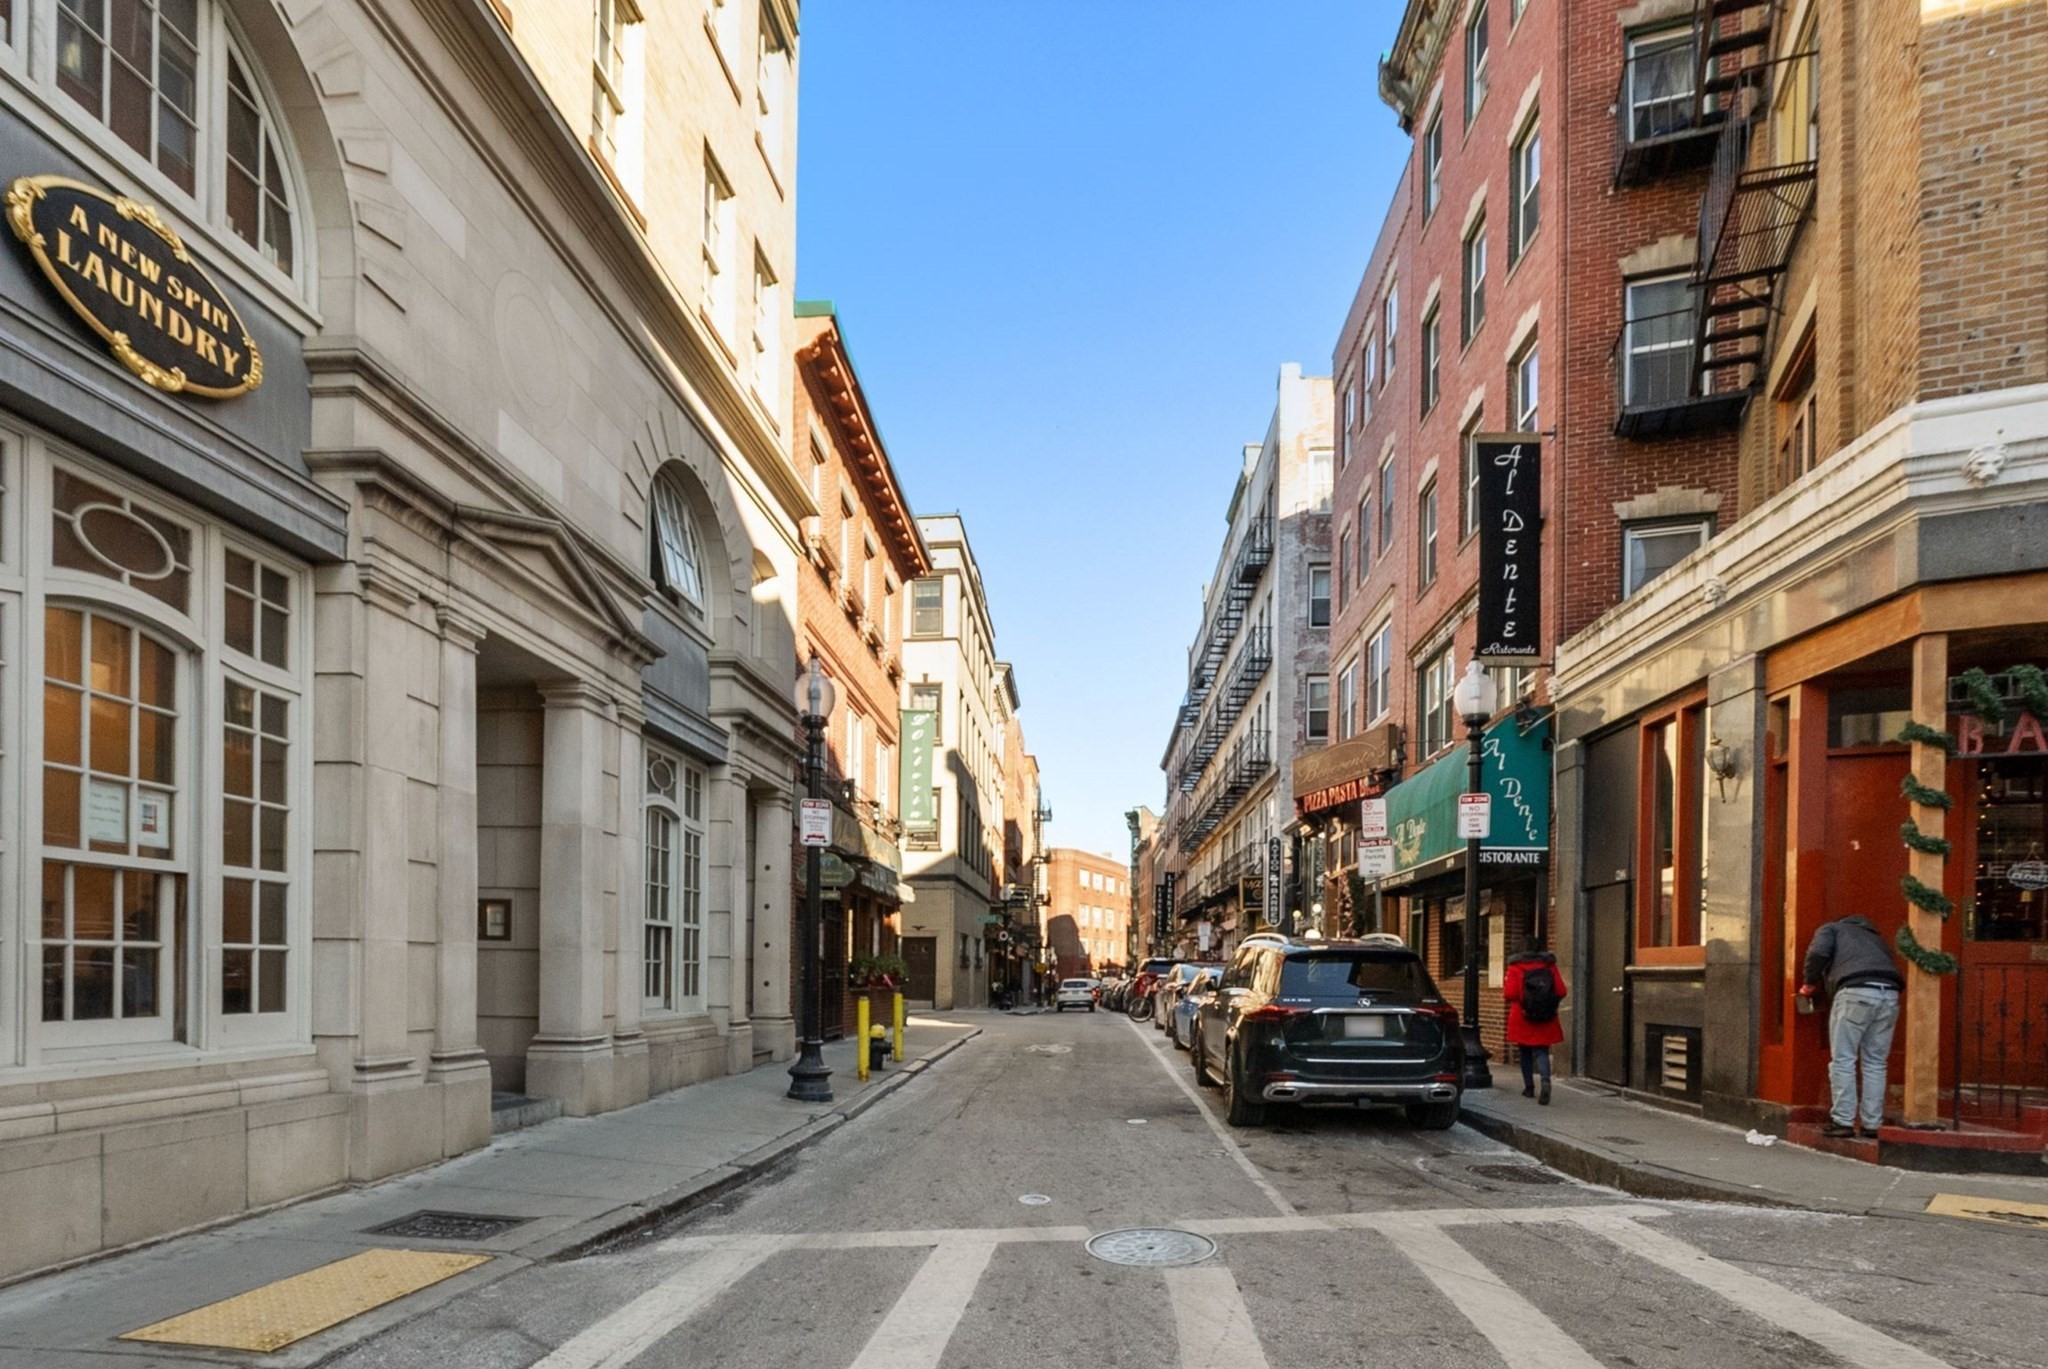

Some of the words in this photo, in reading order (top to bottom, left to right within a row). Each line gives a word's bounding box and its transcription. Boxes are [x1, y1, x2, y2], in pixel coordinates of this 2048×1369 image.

[57, 228, 240, 377] LAUNDRY
[69, 204, 90, 236] A
[98, 221, 163, 286] NEW
[166, 275, 229, 334] SPIN
[1481, 641, 1536, 656] Ristorante
[1303, 789, 1329, 814] PIZZA
[1328, 780, 1358, 806] PASTA
[1481, 738, 1506, 771] Al
[1499, 777, 1538, 841] Dente
[1270, 838, 1280, 872] TATTOO
